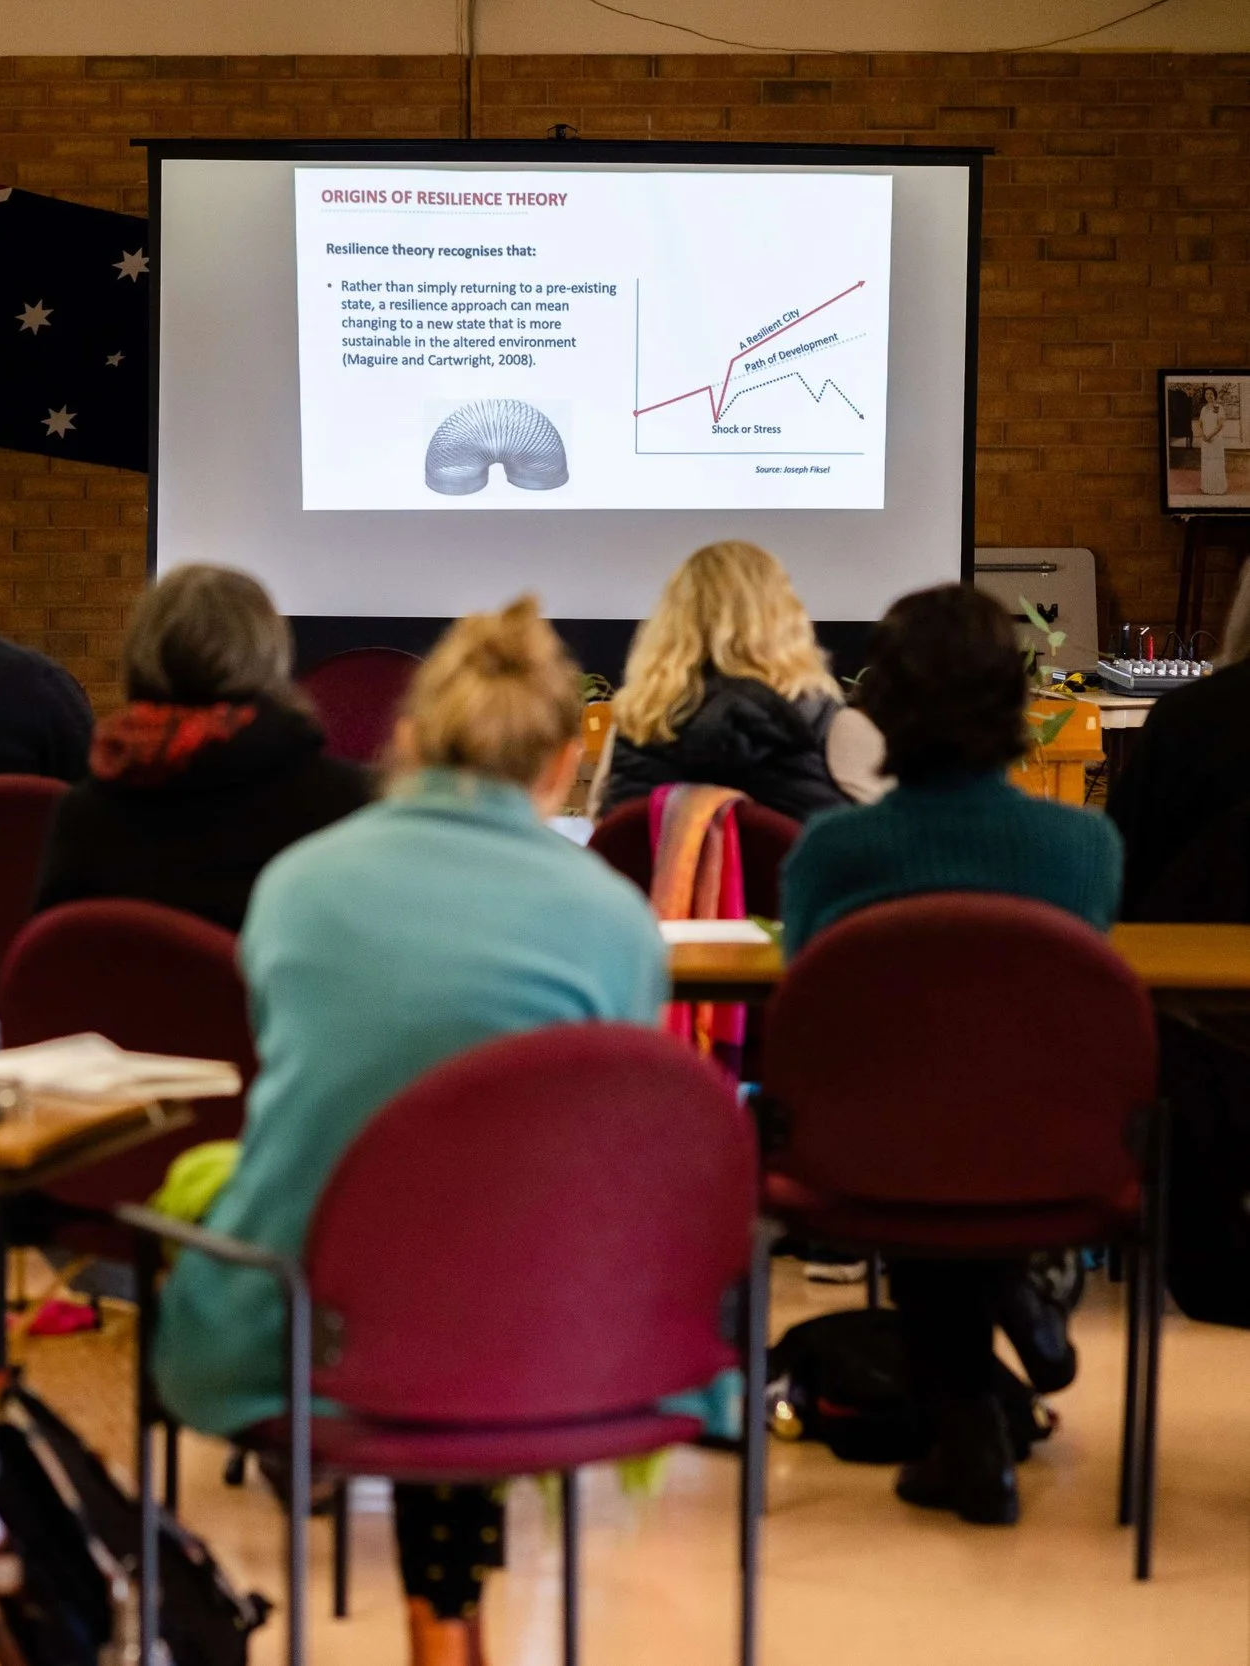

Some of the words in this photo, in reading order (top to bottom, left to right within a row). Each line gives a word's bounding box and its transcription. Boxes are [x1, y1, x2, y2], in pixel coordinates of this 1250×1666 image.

[321, 190, 388, 204] ORIGINS
[390, 190, 413, 205] OF
[416, 191, 503, 207] RESILIENCE
[505, 193, 568, 207] THEORY
[325, 242, 390, 256] Resilience
[391, 243, 436, 260] theory
[437, 245, 504, 260] recognises
[505, 244, 537, 257] that:
[341, 279, 383, 293] Rather
[384, 279, 414, 293] than
[417, 281, 458, 297] simply
[460, 281, 517, 296] returning
[519, 282, 533, 294] to
[535, 284, 543, 294] a
[545, 281, 617, 297] pre-existing
[341, 298, 375, 312] state,
[378, 300, 386, 311] a
[389, 298, 449, 312] resilience
[450, 298, 508, 314] approach
[510, 301, 532, 312] can
[535, 302, 570, 312] mean
[341, 316, 398, 332] changing
[399, 317, 414, 330] to
[416, 319, 424, 330] a
[427, 320, 454, 330] new
[456, 318, 486, 330] state
[488, 316, 514, 330] that
[516, 317, 527, 330] is
[529, 320, 562, 330] more
[739, 340, 749, 351] A
[745, 318, 783, 345] Resilient
[782, 308, 801, 323] City
[341, 334, 412, 348] sustainable
[414, 335, 426, 348] in
[429, 335, 451, 349] the
[452, 335, 496, 348] altered
[498, 335, 577, 348] environment
[342, 352, 399, 369] (Maguire
[401, 353, 425, 366] and
[427, 353, 495, 369] Cartwright,
[498, 353, 536, 368] 2008).
[744, 357, 766, 372] Path
[767, 353, 778, 364] of
[779, 332, 839, 360] Development
[711, 423, 740, 435] Shock
[740, 426, 752, 434] or
[753, 424, 782, 434] Stress
[755, 465, 783, 474] Source:
[783, 465, 809, 475] Joseph
[809, 465, 831, 474] Fiksel
